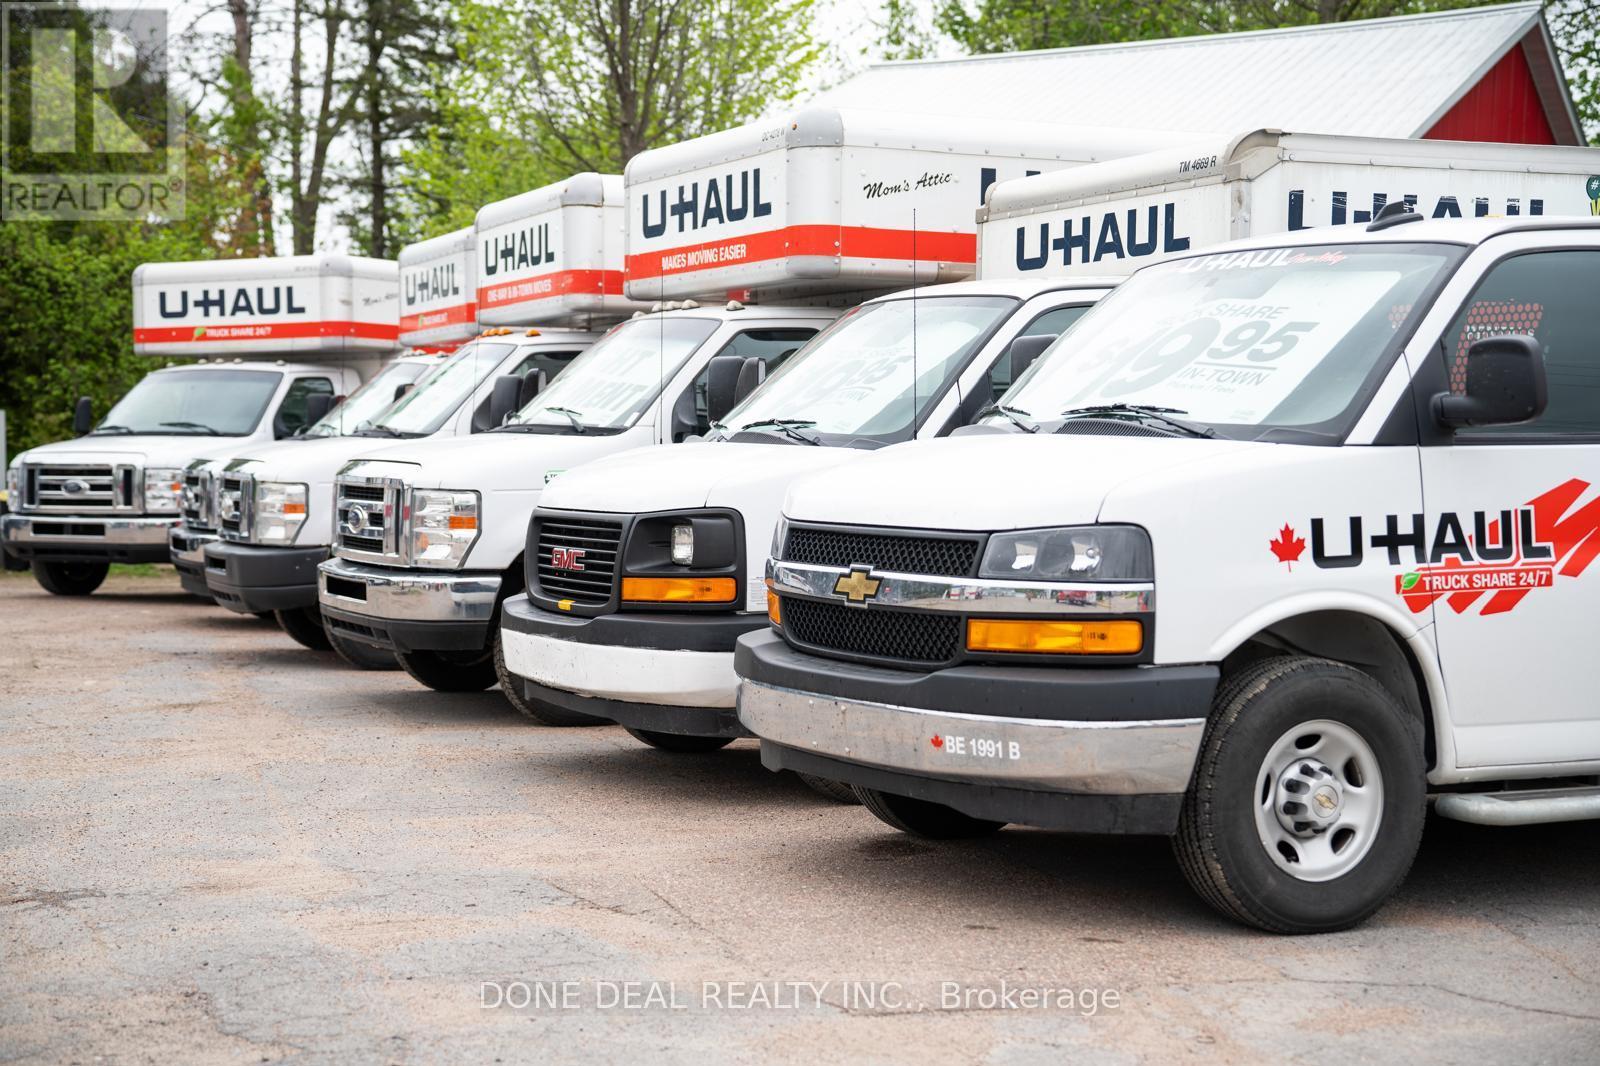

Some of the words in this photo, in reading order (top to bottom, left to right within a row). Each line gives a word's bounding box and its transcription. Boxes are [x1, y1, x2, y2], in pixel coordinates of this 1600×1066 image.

[1179, 160, 1191, 173] TM
[1191, 156, 1210, 170] 4669
[1210, 155, 1217, 168] R
[863, 181, 910, 199] Mom's
[914, 172, 952, 190] Attic
[642, 168, 772, 239] U-HAUL
[485, 222, 555, 276] U-HAUL
[1016, 203, 1190, 271] U-HAUL
[661, 253, 686, 270] MAKES
[687, 248, 718, 266] MOVING
[719, 243, 746, 261] EASIER
[1183, 249, 1293, 273] U-HAUL
[405, 263, 459, 306] U-HAUL
[159, 286, 306, 319] U-HAUL
[1210, 302, 1290, 320] SHARE
[1177, 367, 1272, 387] IN-TOWN
[1310, 509, 1552, 569] U-HAUL
[552, 547, 586, 571] GMC
[1423, 575, 1469, 591] TRUCK
[1472, 572, 1516, 588] SHARE
[1519, 569, 1550, 586] 24/7
[945, 735, 966, 755] BE
[970, 738, 1003, 758] 1991
[1008, 741, 1020, 760] B
